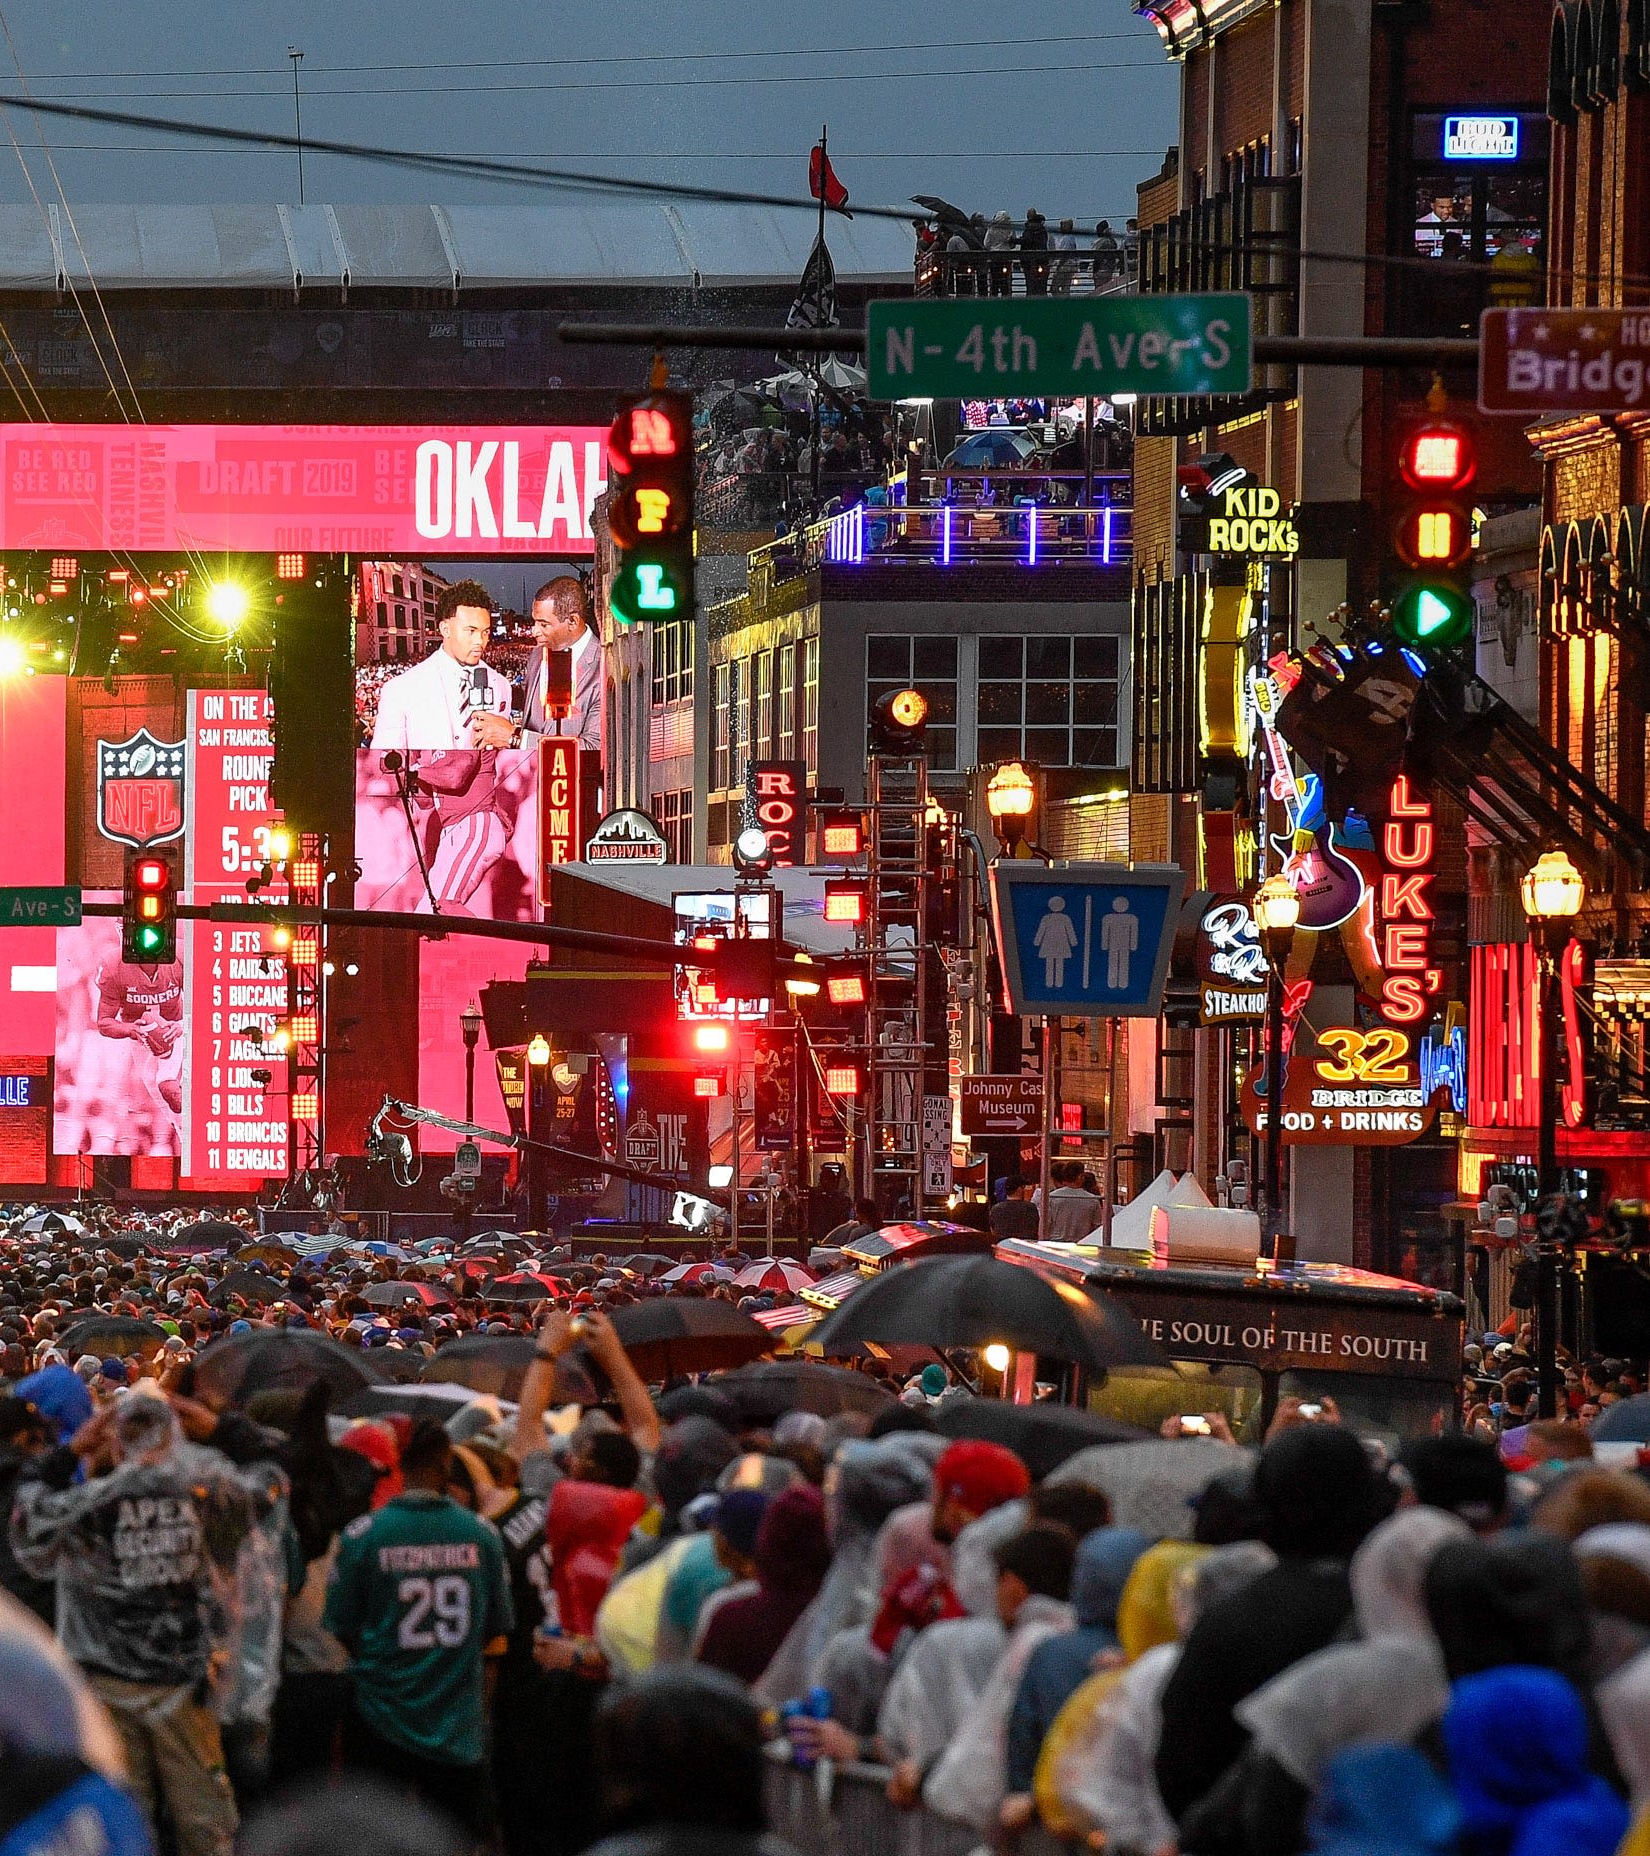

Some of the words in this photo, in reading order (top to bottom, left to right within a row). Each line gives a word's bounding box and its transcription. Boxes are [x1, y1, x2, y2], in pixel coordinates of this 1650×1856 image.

[1507, 349, 1650, 403] Bridg
[18, 449, 43, 470] BE
[52, 449, 91, 470] RED
[12, 472, 49, 493] SEE
[57, 472, 98, 493] RED
[199, 460, 296, 496] DRAFT
[306, 462, 353, 493] 2019
[1225, 487, 1280, 517] KID
[204, 695, 224, 720] ON
[230, 695, 259, 720] THE
[199, 729, 220, 746] SAN
[108, 782, 178, 836] NFL
[229, 786, 267, 811] PICK
[549, 748, 568, 865] ACME
[757, 772, 796, 866] ROC
[591, 844, 663, 858] NASHVILLE
[1381, 774, 1441, 1021] LUKE'S
[212, 931, 222, 952] 3
[230, 931, 261, 952] JETS
[212, 959, 222, 980] 4
[126, 987, 180, 1005] SOONERS
[212, 986, 222, 1007] 5
[212, 1013, 222, 1034] 6
[212, 1040, 222, 1061] 7
[1316, 1029, 1409, 1082] 32
[212, 1067, 222, 1088] 8
[228, 1067, 264, 1088] LION
[503, 1066, 517, 1079] THE
[964, 1081, 1013, 1098] Johnny
[1311, 1089, 1424, 1107] BRIDGE
[212, 1095, 222, 1115] 9
[228, 1095, 264, 1115] BILLS
[557, 1096, 576, 1107] APRIL
[979, 1100, 1036, 1115] Museum
[556, 1108, 576, 1118] 25-27
[1256, 1113, 1314, 1131] FOD
[1340, 1112, 1424, 1131] DRINKS
[206, 1122, 220, 1143] 10
[228, 1122, 287, 1143] BRONCOS
[657, 1114, 688, 1171] THE
[628, 1141, 657, 1156] DRAFT
[208, 1149, 220, 1170] 11
[227, 1149, 286, 1170] BENGALS
[1169, 1320, 1235, 1347] SOUL
[1241, 1326, 1275, 1350] OF
[1281, 1330, 1332, 1354] THE
[1339, 1334, 1428, 1362] SOUTH
[398, 1574, 472, 1650] 29
